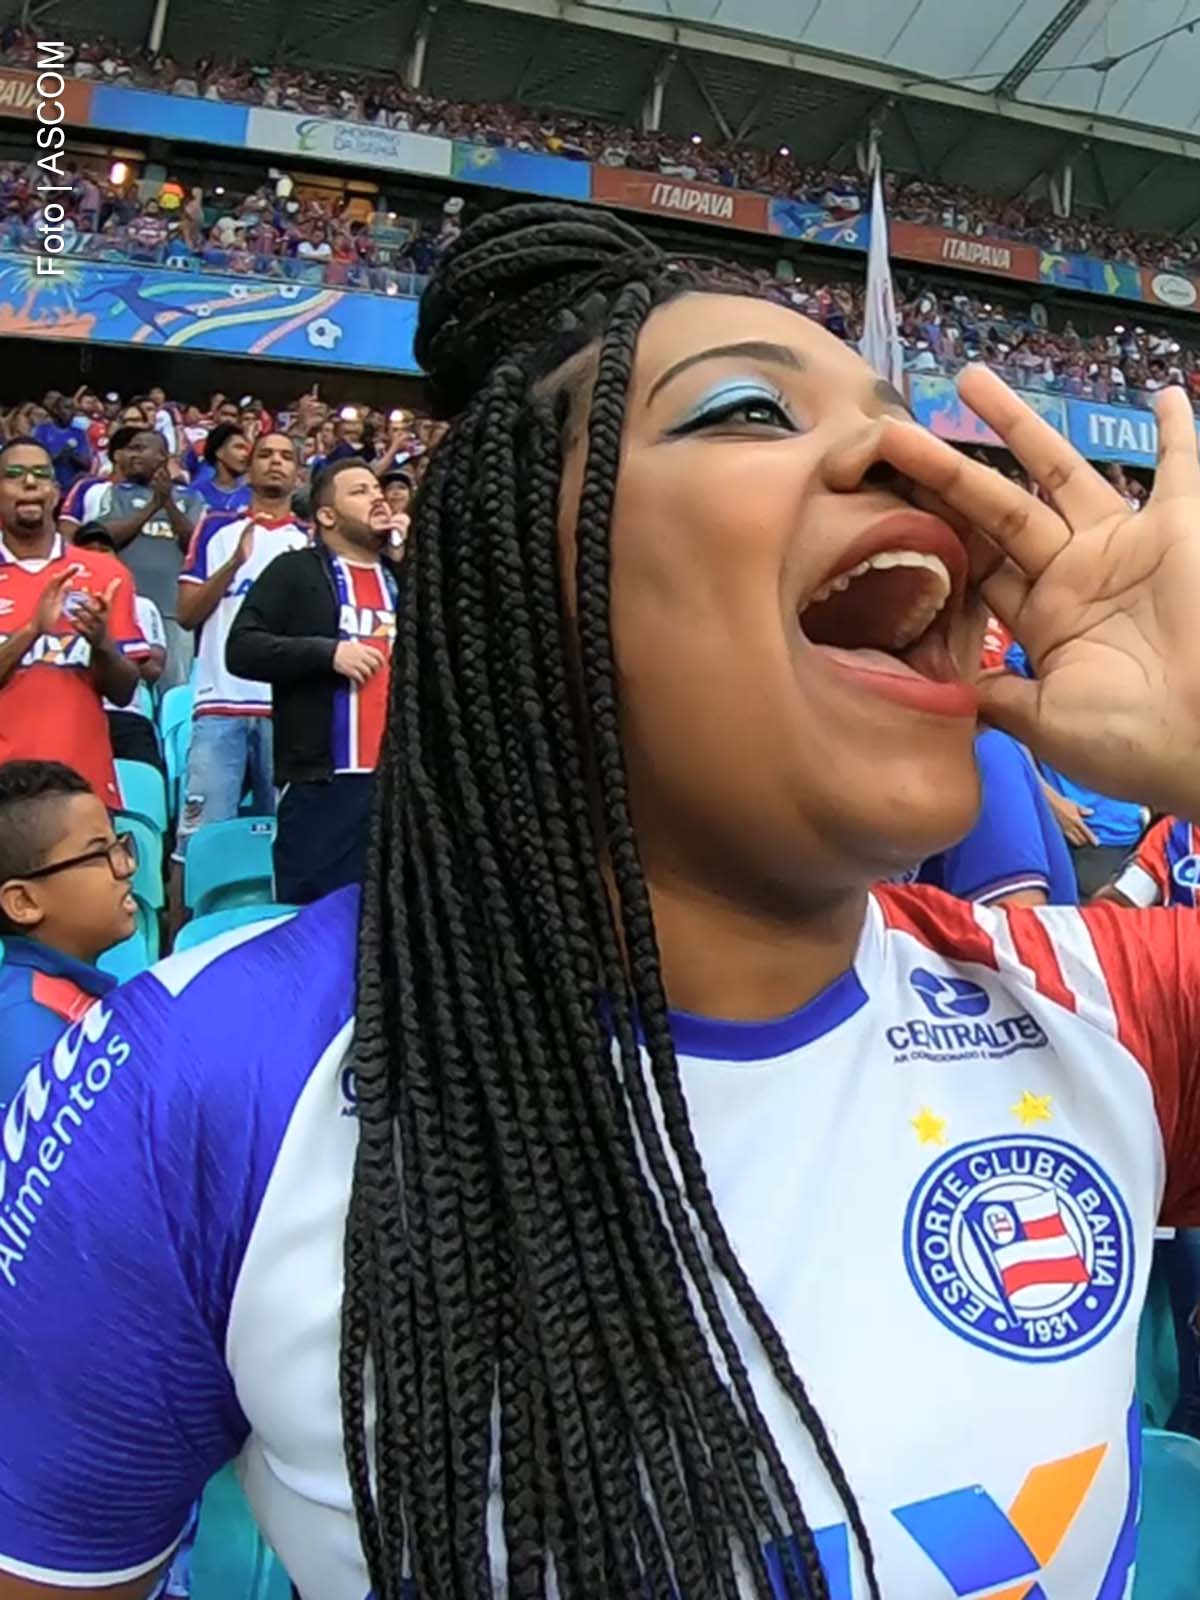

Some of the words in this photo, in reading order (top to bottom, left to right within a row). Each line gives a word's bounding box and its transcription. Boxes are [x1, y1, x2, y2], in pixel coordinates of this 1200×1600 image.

[651, 183, 733, 218] ITAIPAVA
[942, 237, 1010, 270] ITAIPAVA
[0, 1035, 131, 1287] Alimentos
[923, 1172, 986, 1324] ESPORTE
[969, 1150, 1077, 1190] CLUBE
[1076, 1188, 1117, 1287] BAHIA
[1024, 1312, 1078, 1343] 1931
